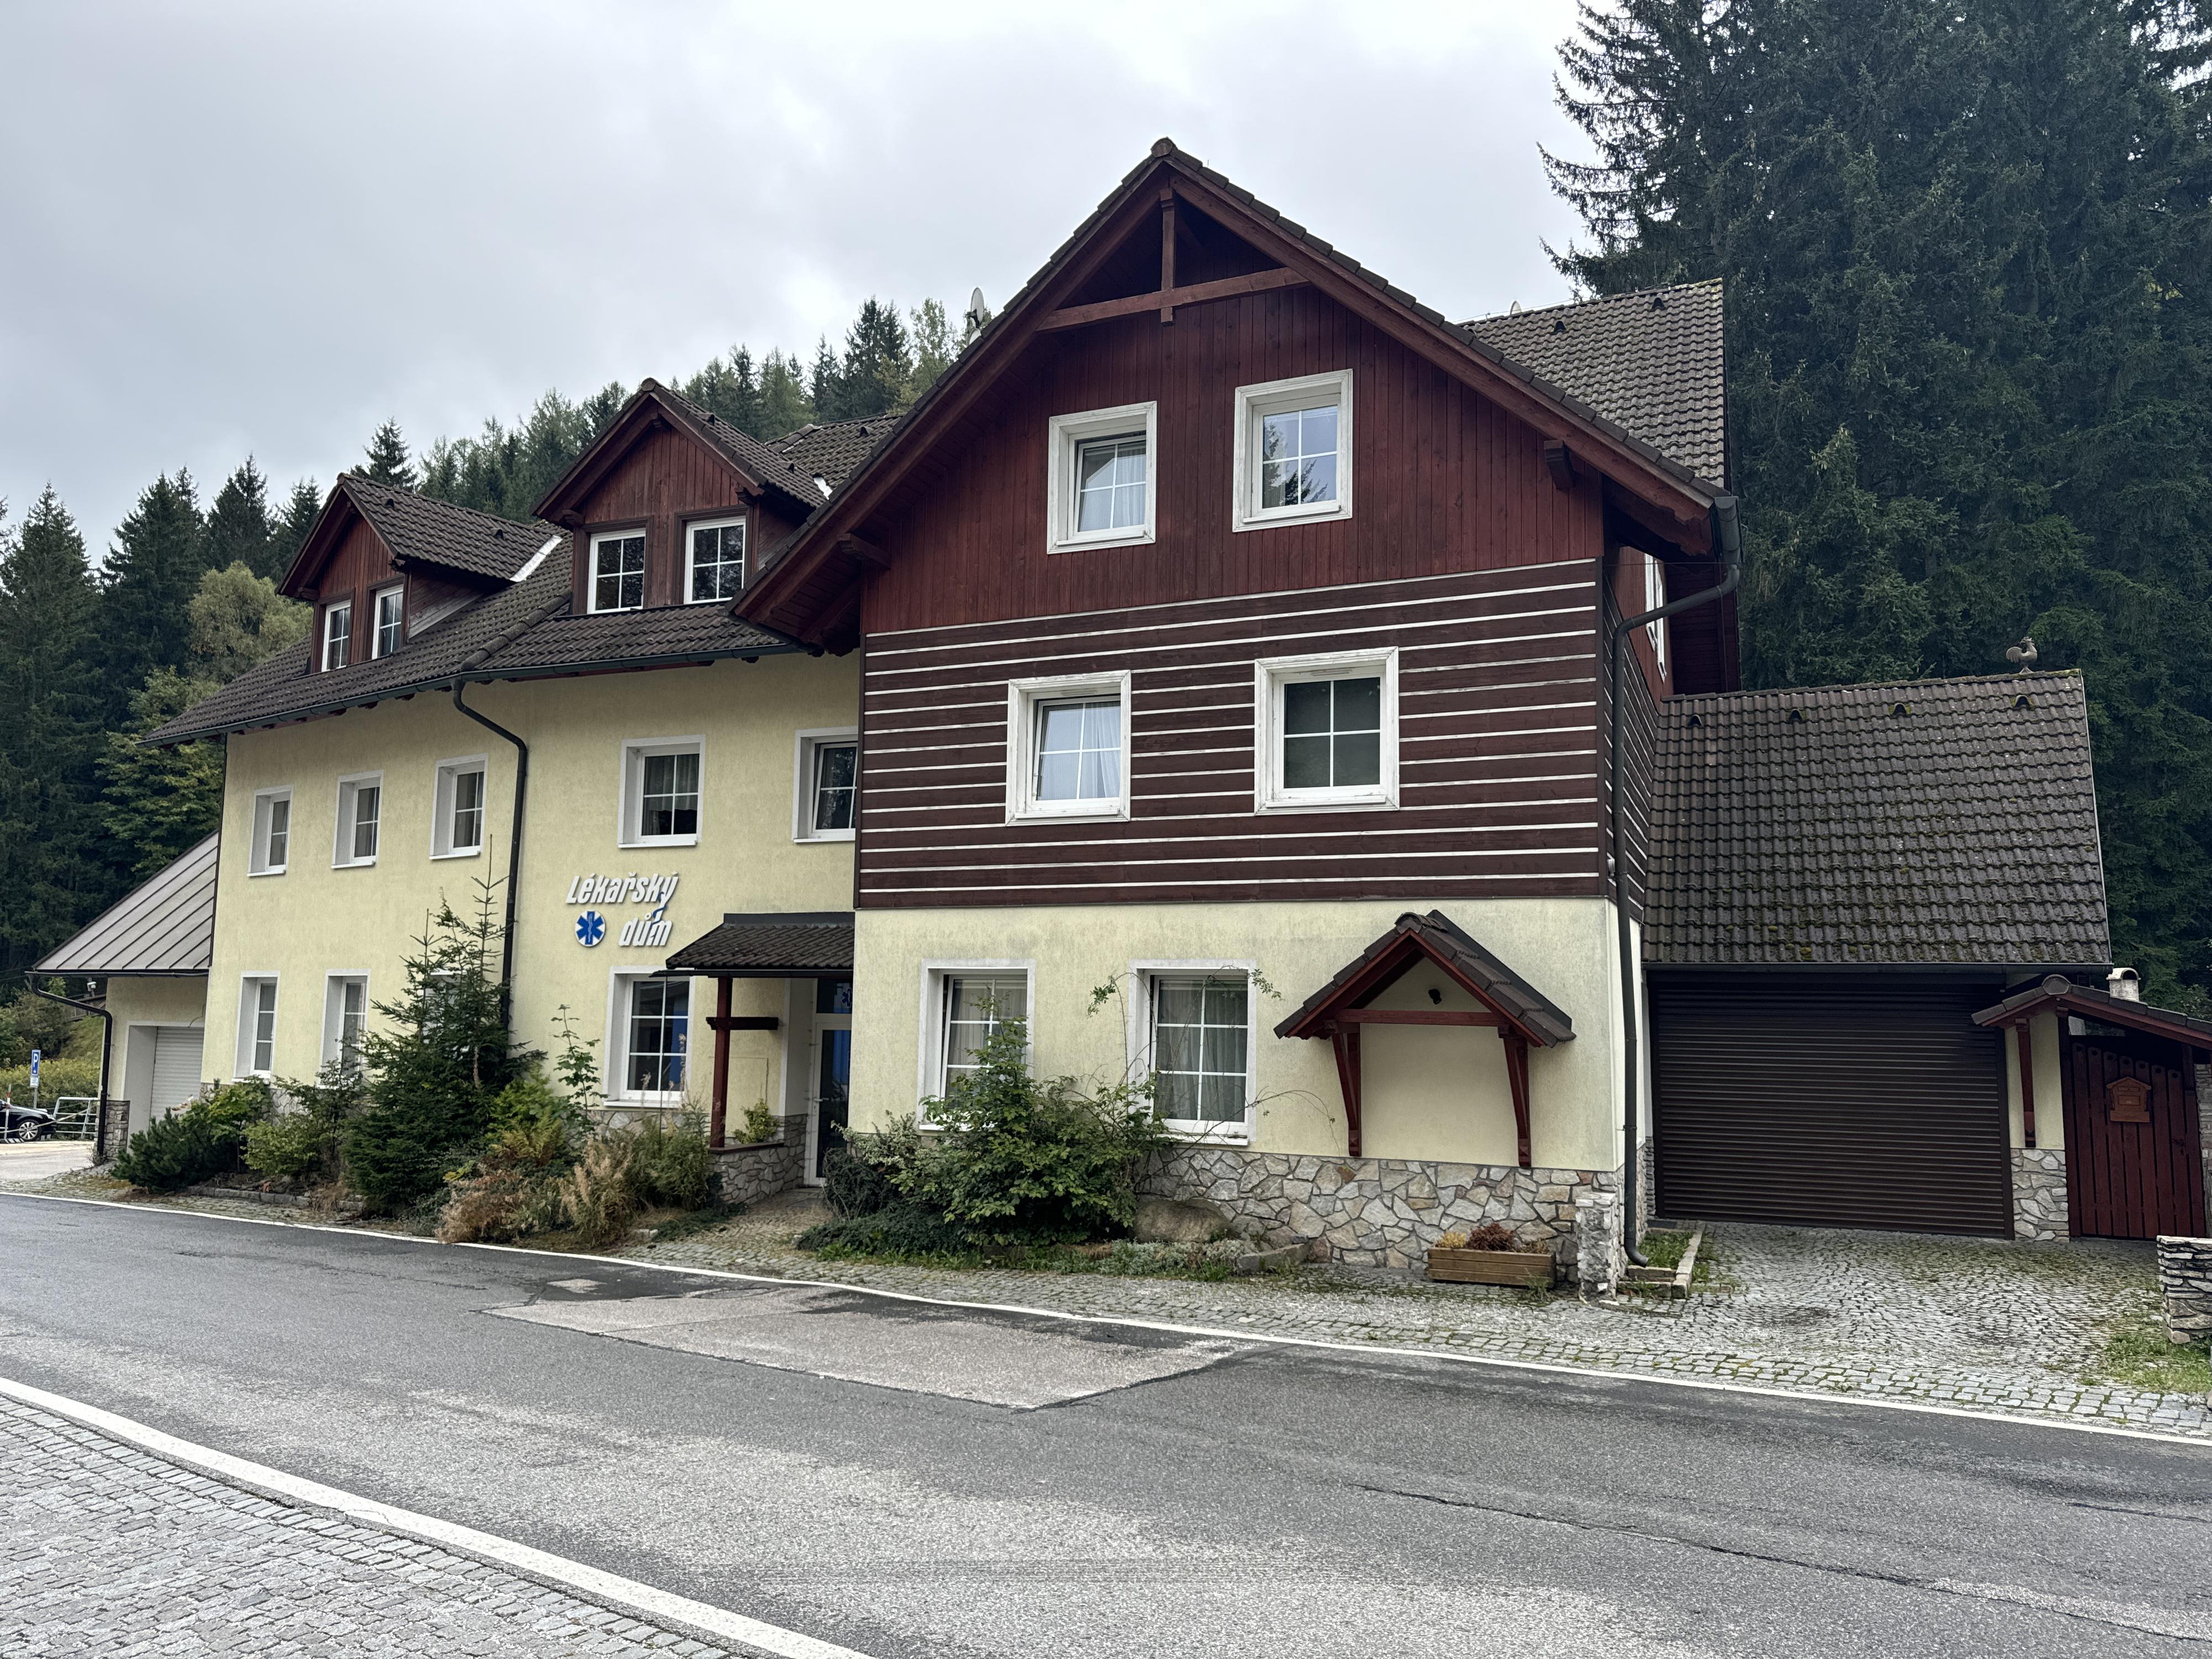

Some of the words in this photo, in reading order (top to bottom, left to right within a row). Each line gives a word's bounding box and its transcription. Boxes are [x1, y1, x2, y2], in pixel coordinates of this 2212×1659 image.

[566, 871, 679, 921] Lékařský
[618, 912, 672, 946] dům
[33, 1053, 38, 1068] P
